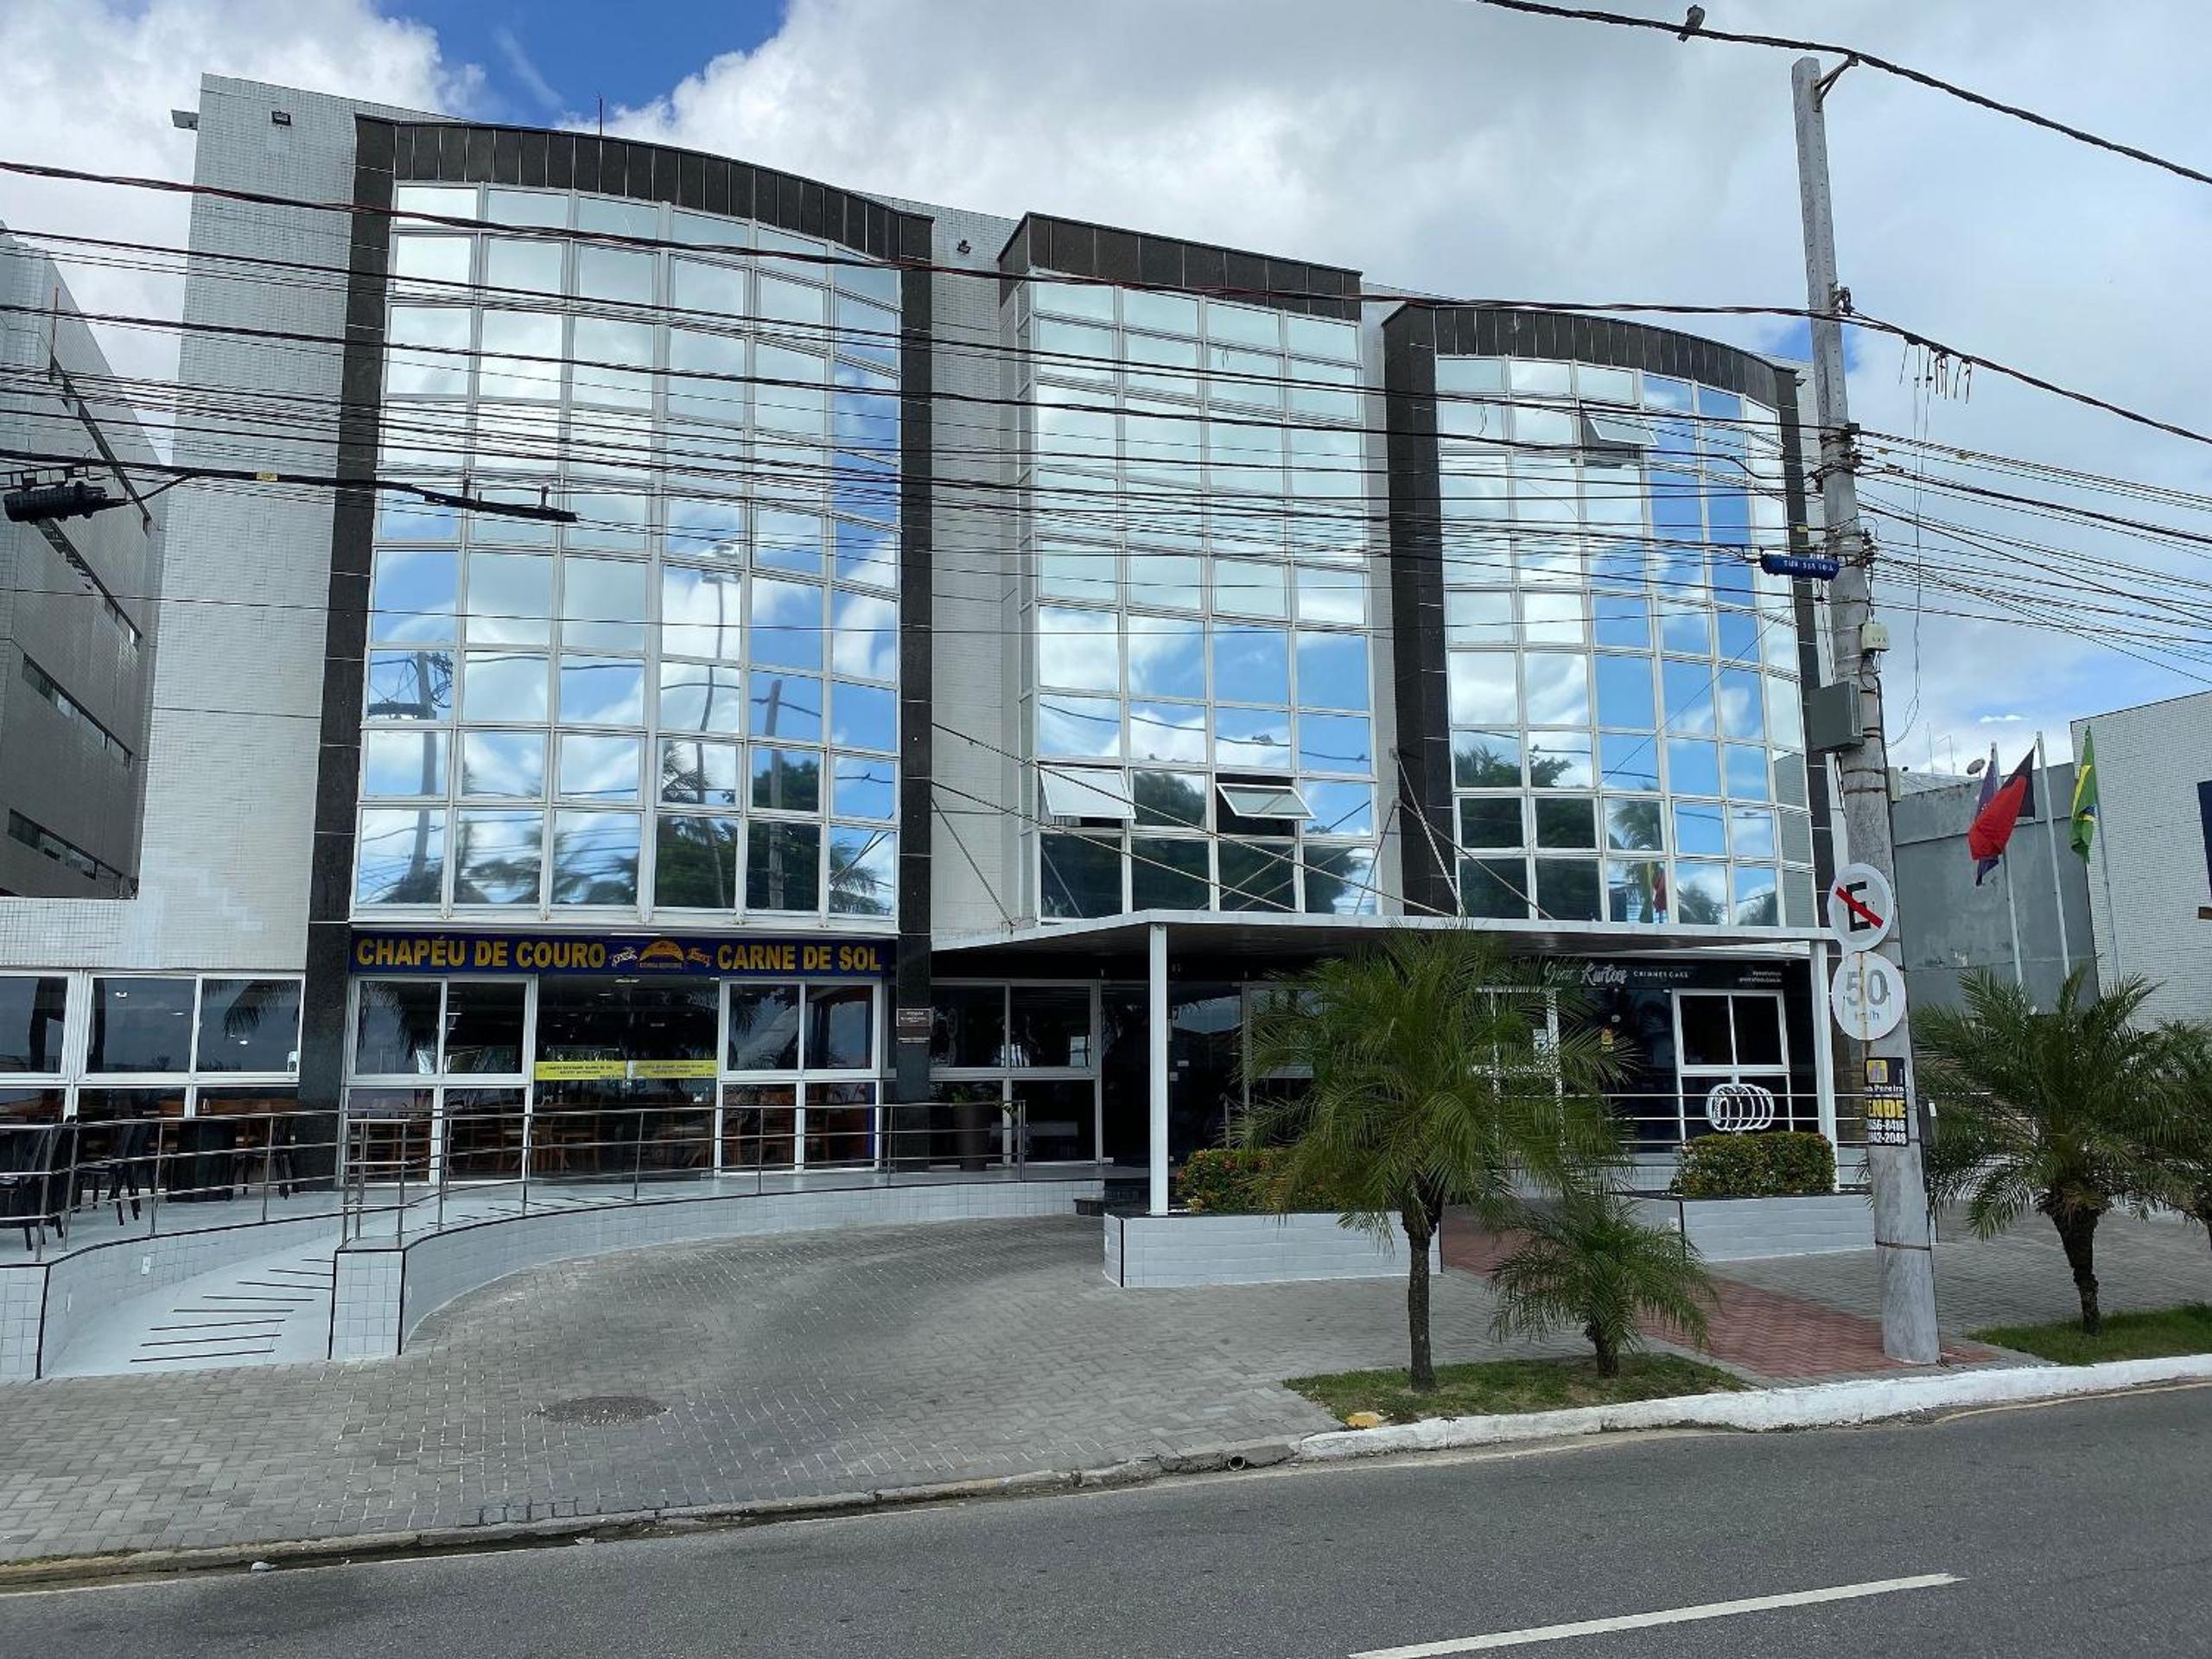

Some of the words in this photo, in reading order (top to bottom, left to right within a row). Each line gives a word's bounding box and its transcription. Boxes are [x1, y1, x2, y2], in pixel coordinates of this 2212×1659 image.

[357, 936, 465, 966] CHAPÉU
[476, 940, 508, 967] DE
[516, 941, 606, 969] COURO
[717, 944, 795, 970] CARNE
[804, 946, 831, 969] DE
[838, 947, 881, 971] SOL
[1847, 969, 1888, 1006] 50
